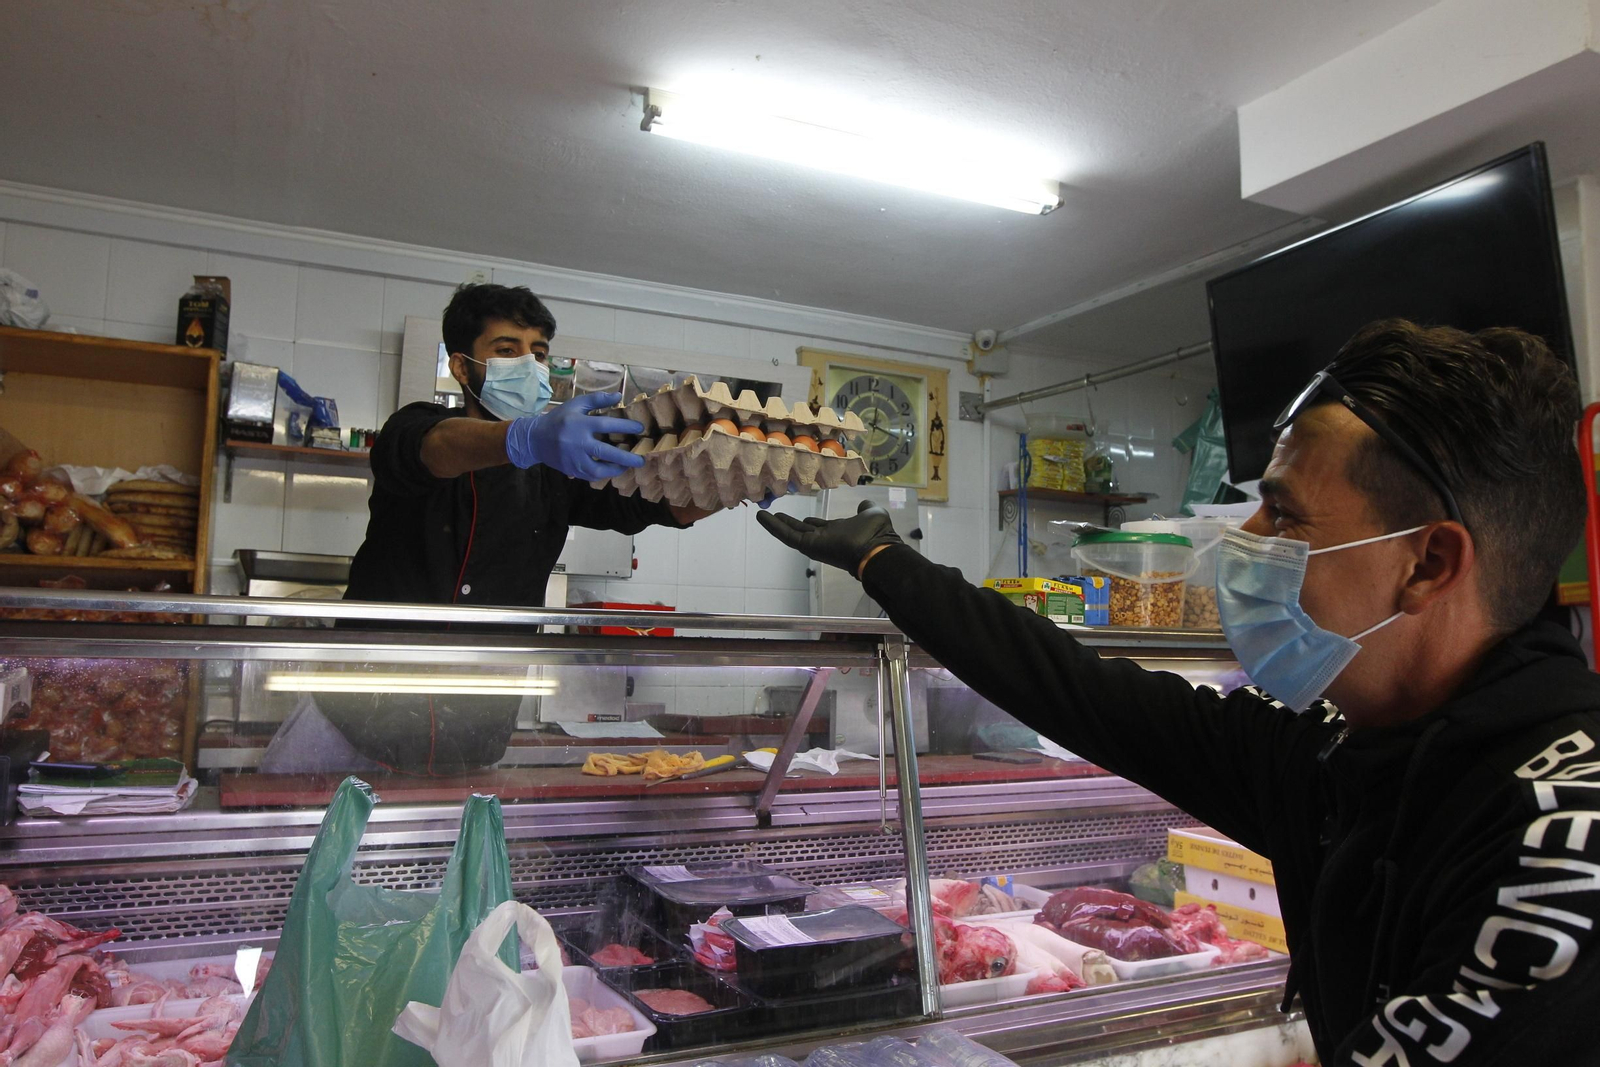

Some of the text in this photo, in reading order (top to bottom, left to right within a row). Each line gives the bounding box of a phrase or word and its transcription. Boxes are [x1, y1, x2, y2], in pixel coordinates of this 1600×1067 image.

[849, 381, 859, 396] 11
[868, 378, 880, 392] 12
[889, 386, 895, 400] 1
[836, 394, 848, 409] 10
[901, 402, 910, 417] 2
[906, 422, 915, 438] 3
[900, 441, 910, 456] 4
[870, 461, 879, 476] 6
[888, 458, 898, 473] 5
